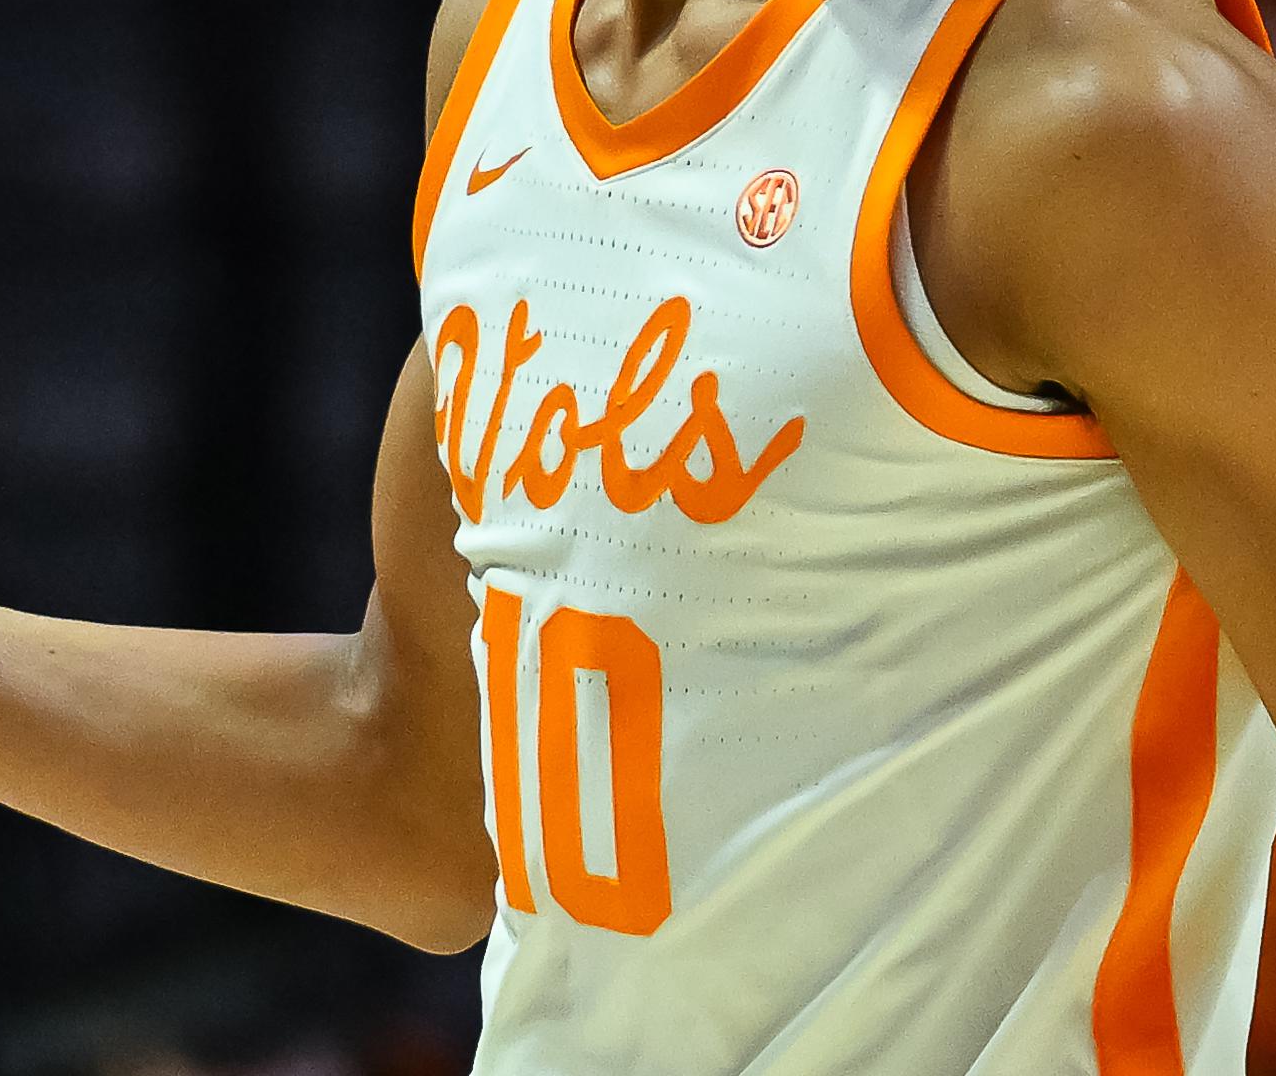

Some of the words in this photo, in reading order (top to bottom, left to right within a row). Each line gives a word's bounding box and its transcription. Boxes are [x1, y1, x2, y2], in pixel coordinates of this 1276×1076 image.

[742, 177, 793, 240] SEC
[434, 296, 806, 525] Vols
[480, 584, 673, 938] 10
